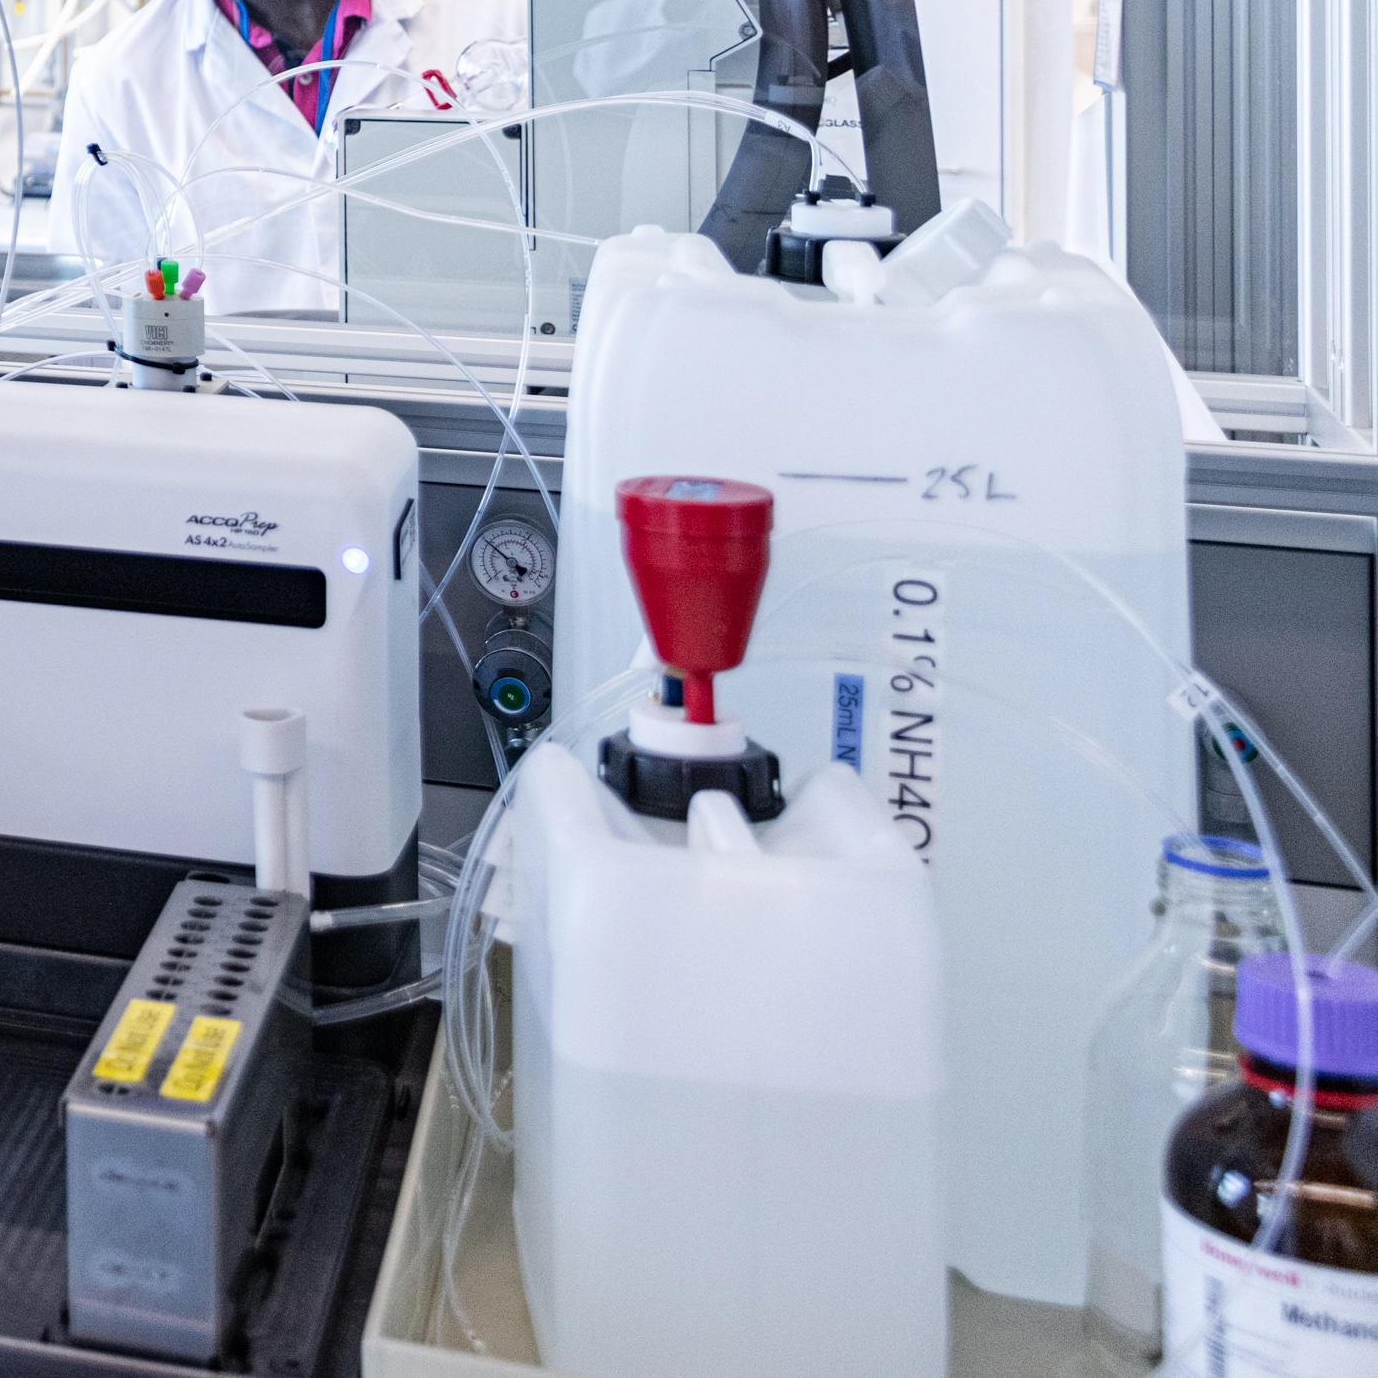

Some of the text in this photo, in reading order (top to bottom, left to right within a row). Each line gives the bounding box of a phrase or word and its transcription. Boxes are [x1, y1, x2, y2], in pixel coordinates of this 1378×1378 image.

[145, 325, 168, 340] VICI
[185, 534, 279, 553] AS 4x2 AutoSampler
[889, 579, 938, 694] 0.1%
[837, 683, 859, 738] 25mL
